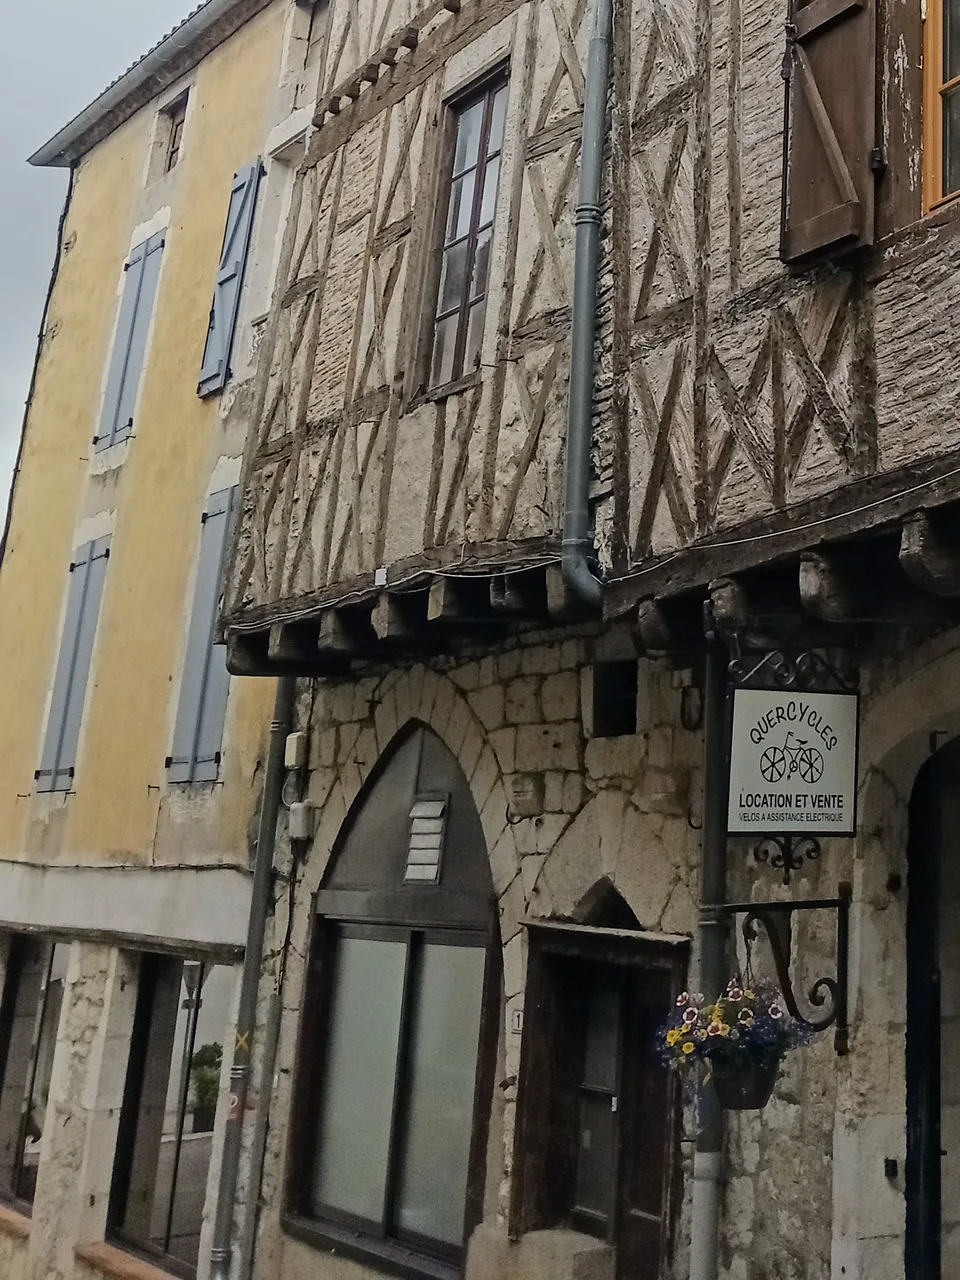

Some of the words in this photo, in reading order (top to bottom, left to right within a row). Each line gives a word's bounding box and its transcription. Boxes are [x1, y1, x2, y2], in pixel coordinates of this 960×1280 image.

[749, 701, 838, 751] QUERCYCLES
[739, 794, 792, 808] LOCATION
[795, 794, 808, 808] ET
[811, 794, 843, 808] VENTE
[739, 813, 760, 822] VELOS
[761, 813, 765, 822] A
[767, 813, 804, 822] ASSISTANCE
[806, 813, 843, 822] ELECTRIQUE
[517, 1013, 521, 1028] 1
